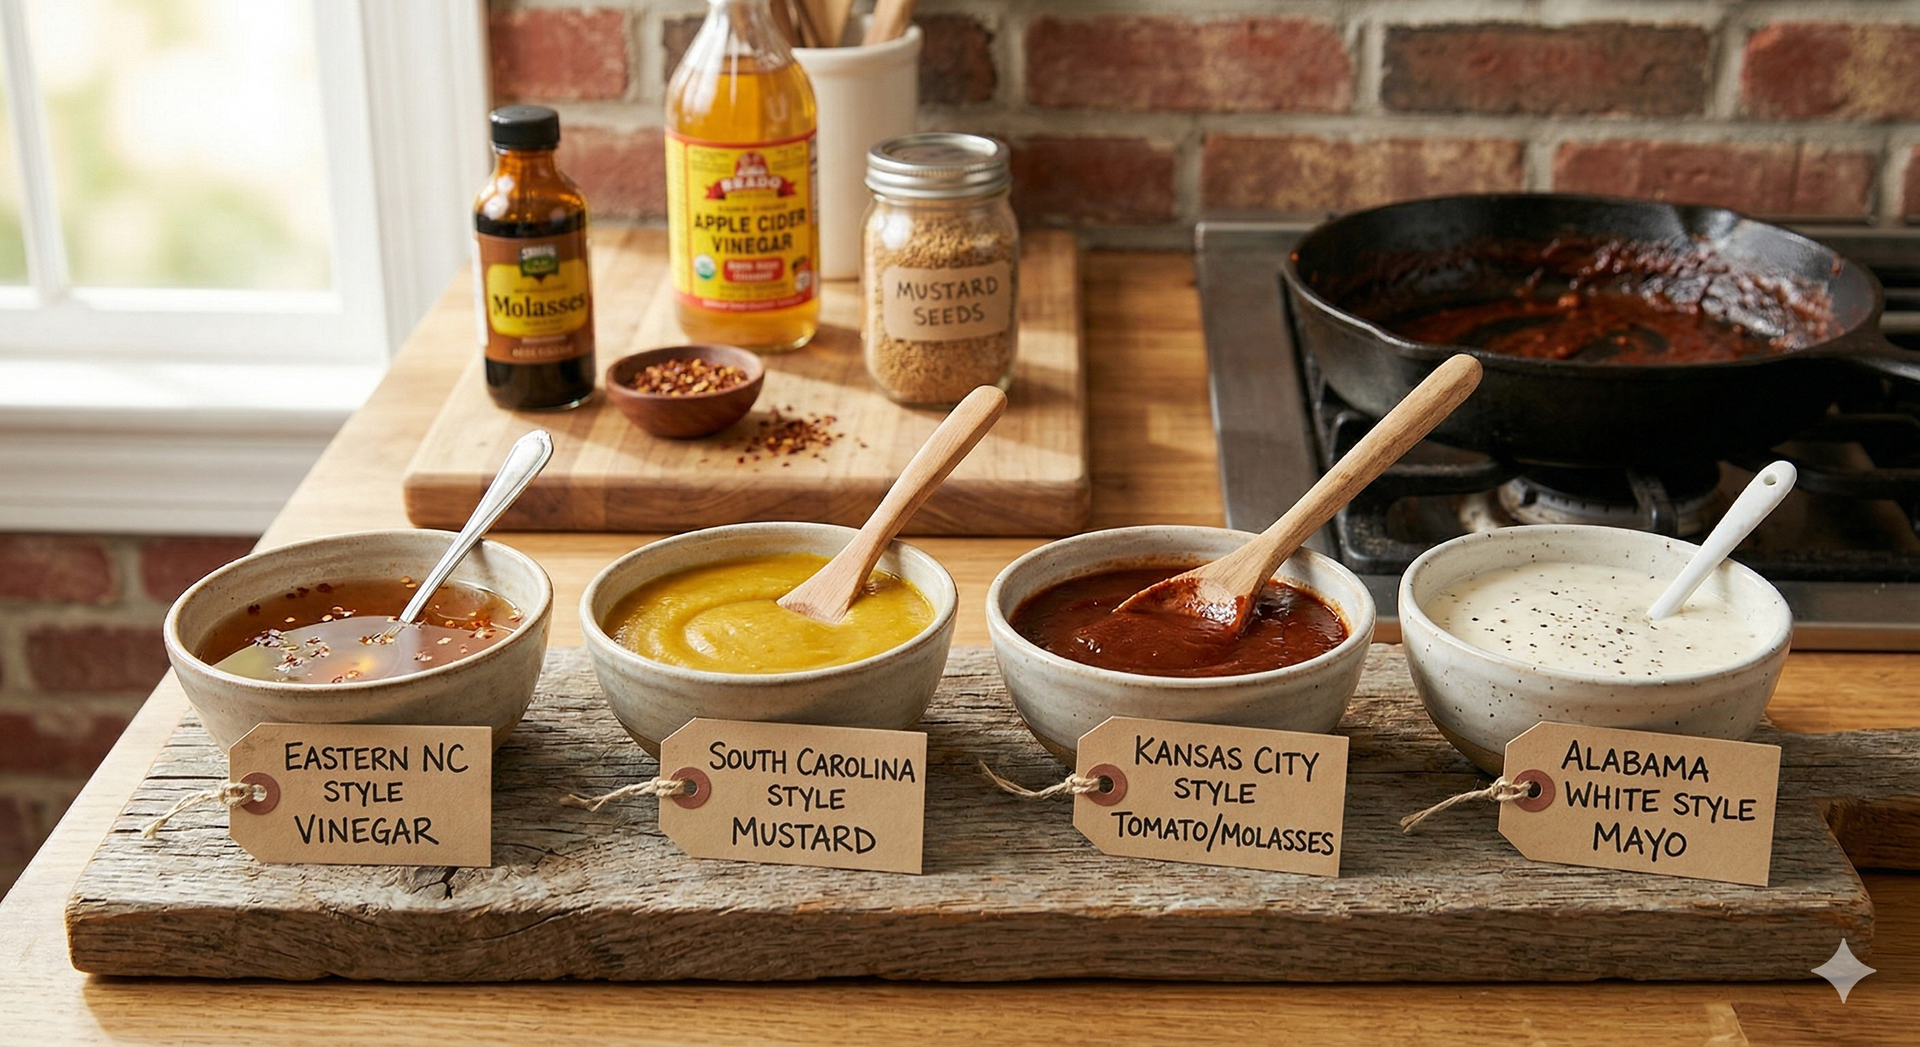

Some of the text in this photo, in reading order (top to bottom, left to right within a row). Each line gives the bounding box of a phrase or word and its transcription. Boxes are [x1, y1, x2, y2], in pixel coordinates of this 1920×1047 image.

[695, 207, 806, 233] APPLE CIDER
[711, 233, 793, 255] VINEGAR
[896, 275, 999, 302] MUSTARD
[493, 293, 585, 318] Molasses
[913, 302, 985, 327] SEEDS
[284, 741, 469, 772] EASTERN NC
[709, 740, 915, 783] SOUTH CAROLINA
[1134, 735, 1320, 782] KANSAS CITY
[1560, 739, 1709, 783] ALABAMA
[323, 779, 403, 807] STYLE
[767, 783, 846, 812] STYLE
[1173, 777, 1257, 806] STYLE
[1564, 780, 1757, 824] WHITE STYLE
[294, 813, 440, 846] VINEGAR
[732, 816, 876, 854] MUSTARD
[1110, 811, 1335, 856] TOMATO/MOLASSES
[1592, 821, 1687, 863] MAYO
